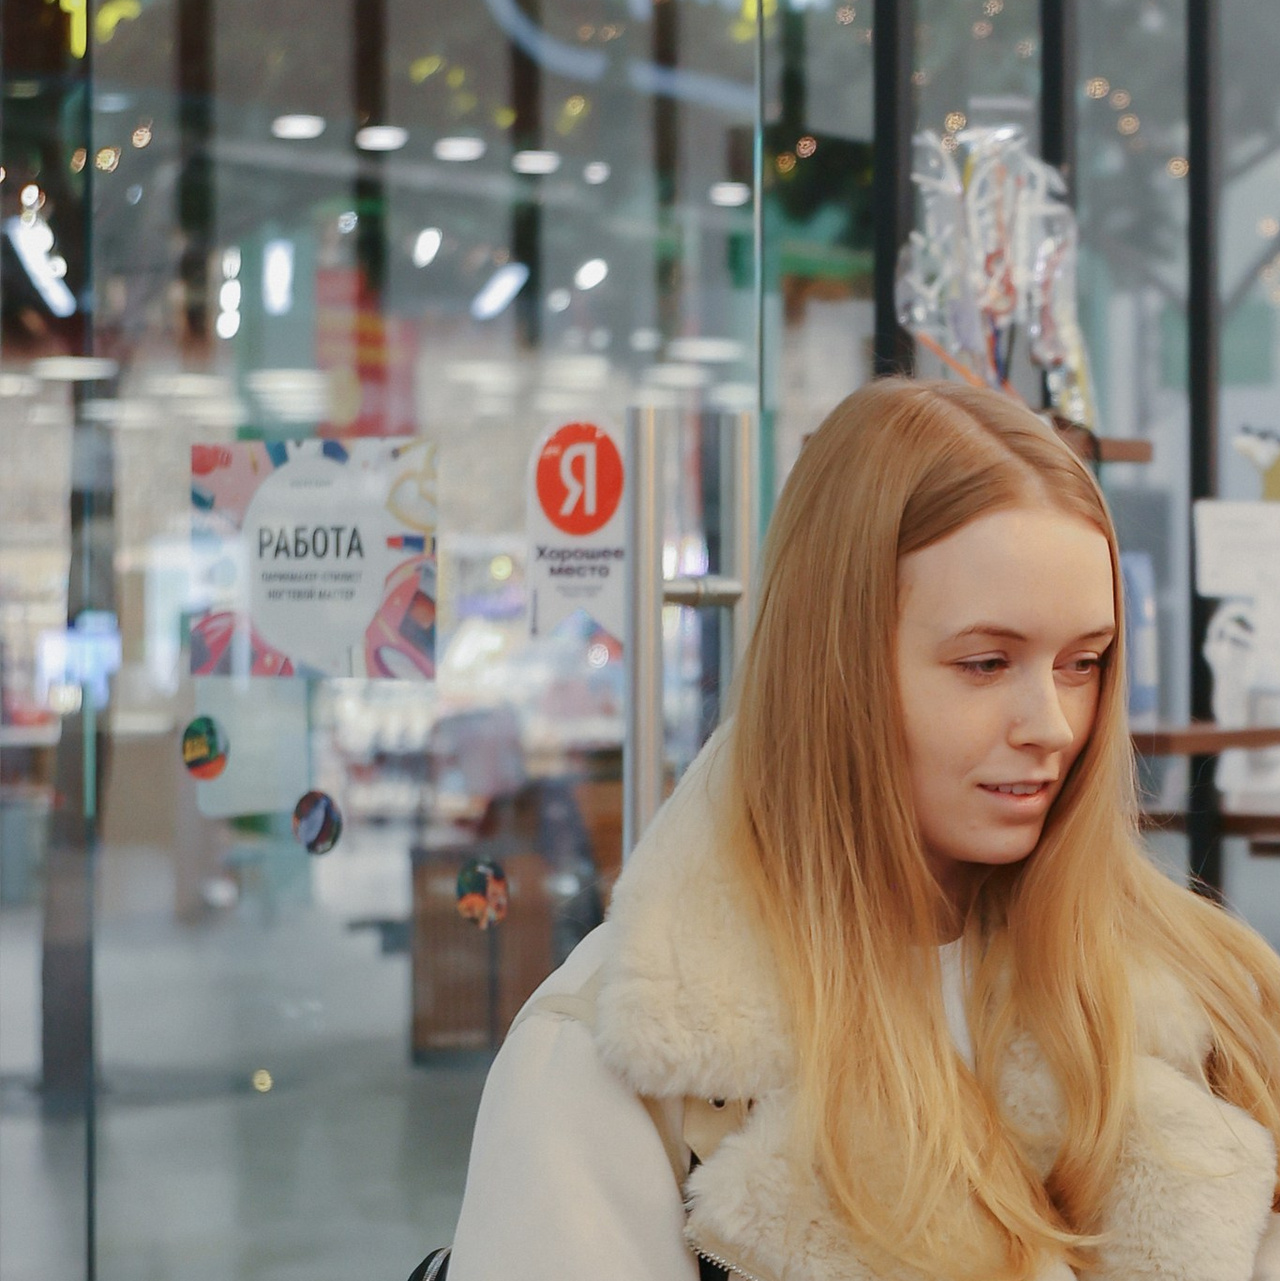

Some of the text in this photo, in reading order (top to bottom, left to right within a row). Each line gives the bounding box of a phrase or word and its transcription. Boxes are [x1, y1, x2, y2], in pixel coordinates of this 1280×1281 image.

[559, 441, 598, 516] Я
[258, 527, 365, 559] РАБОТА
[536, 546, 624, 563] Хорошее
[550, 565, 610, 578] место
